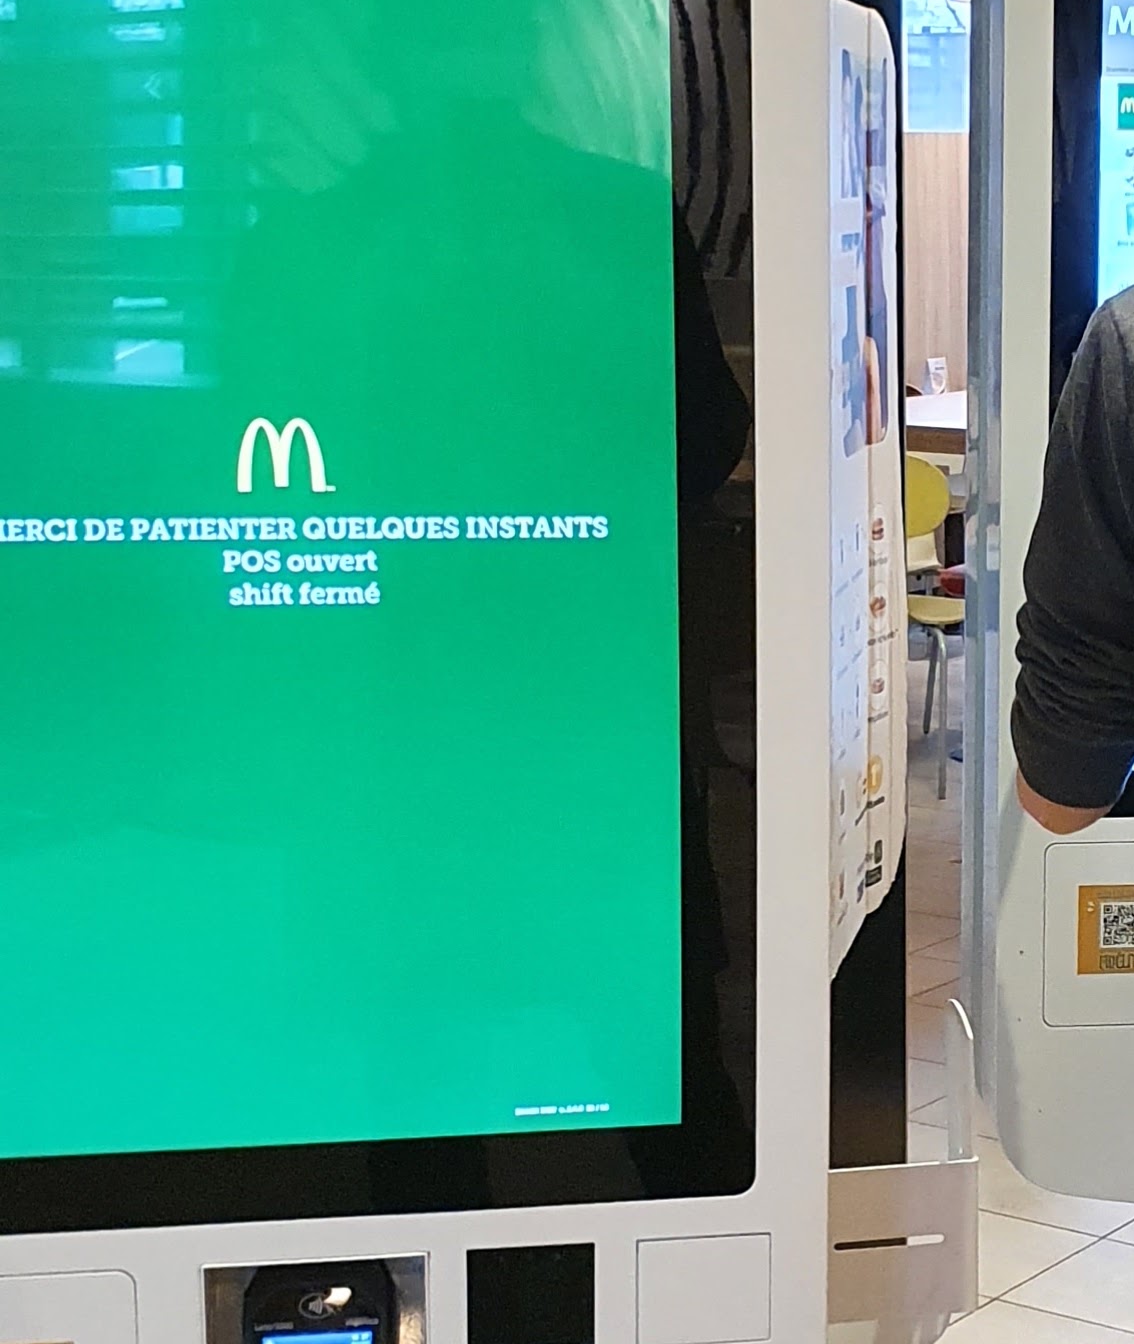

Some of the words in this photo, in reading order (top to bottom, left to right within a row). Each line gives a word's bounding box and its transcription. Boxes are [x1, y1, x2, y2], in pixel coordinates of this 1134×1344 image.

[0, 519, 77, 543] ERCI
[83, 519, 125, 542] DE
[130, 518, 297, 542] PATIENTER
[302, 517, 459, 542] QUELQUES
[465, 515, 608, 540] INSTANTS
[223, 550, 283, 574] POS
[286, 550, 378, 573] ouvert
[229, 582, 293, 606] shift
[299, 581, 381, 605] fermé
